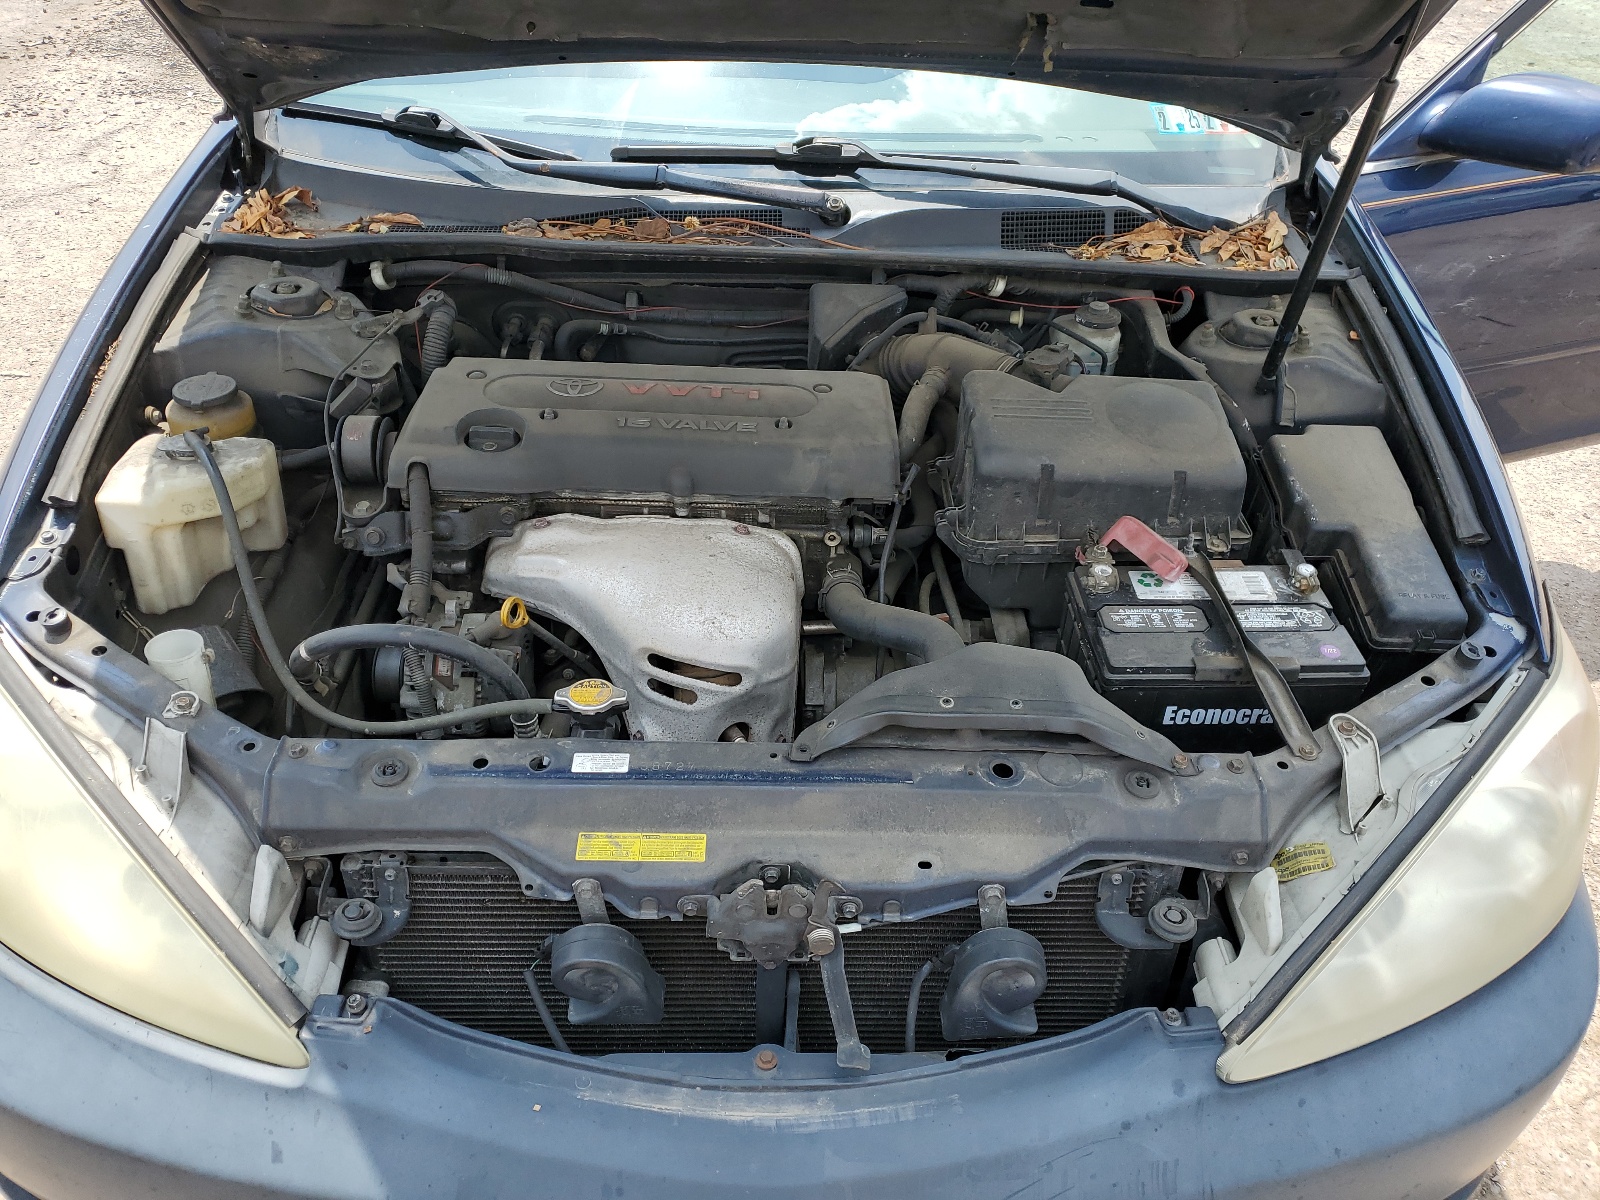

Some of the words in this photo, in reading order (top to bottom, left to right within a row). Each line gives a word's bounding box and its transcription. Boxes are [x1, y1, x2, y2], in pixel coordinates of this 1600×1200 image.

[616, 416, 651, 428] 16
[657, 417, 760, 433] VALVE
[1162, 705, 1274, 725] Econocra
